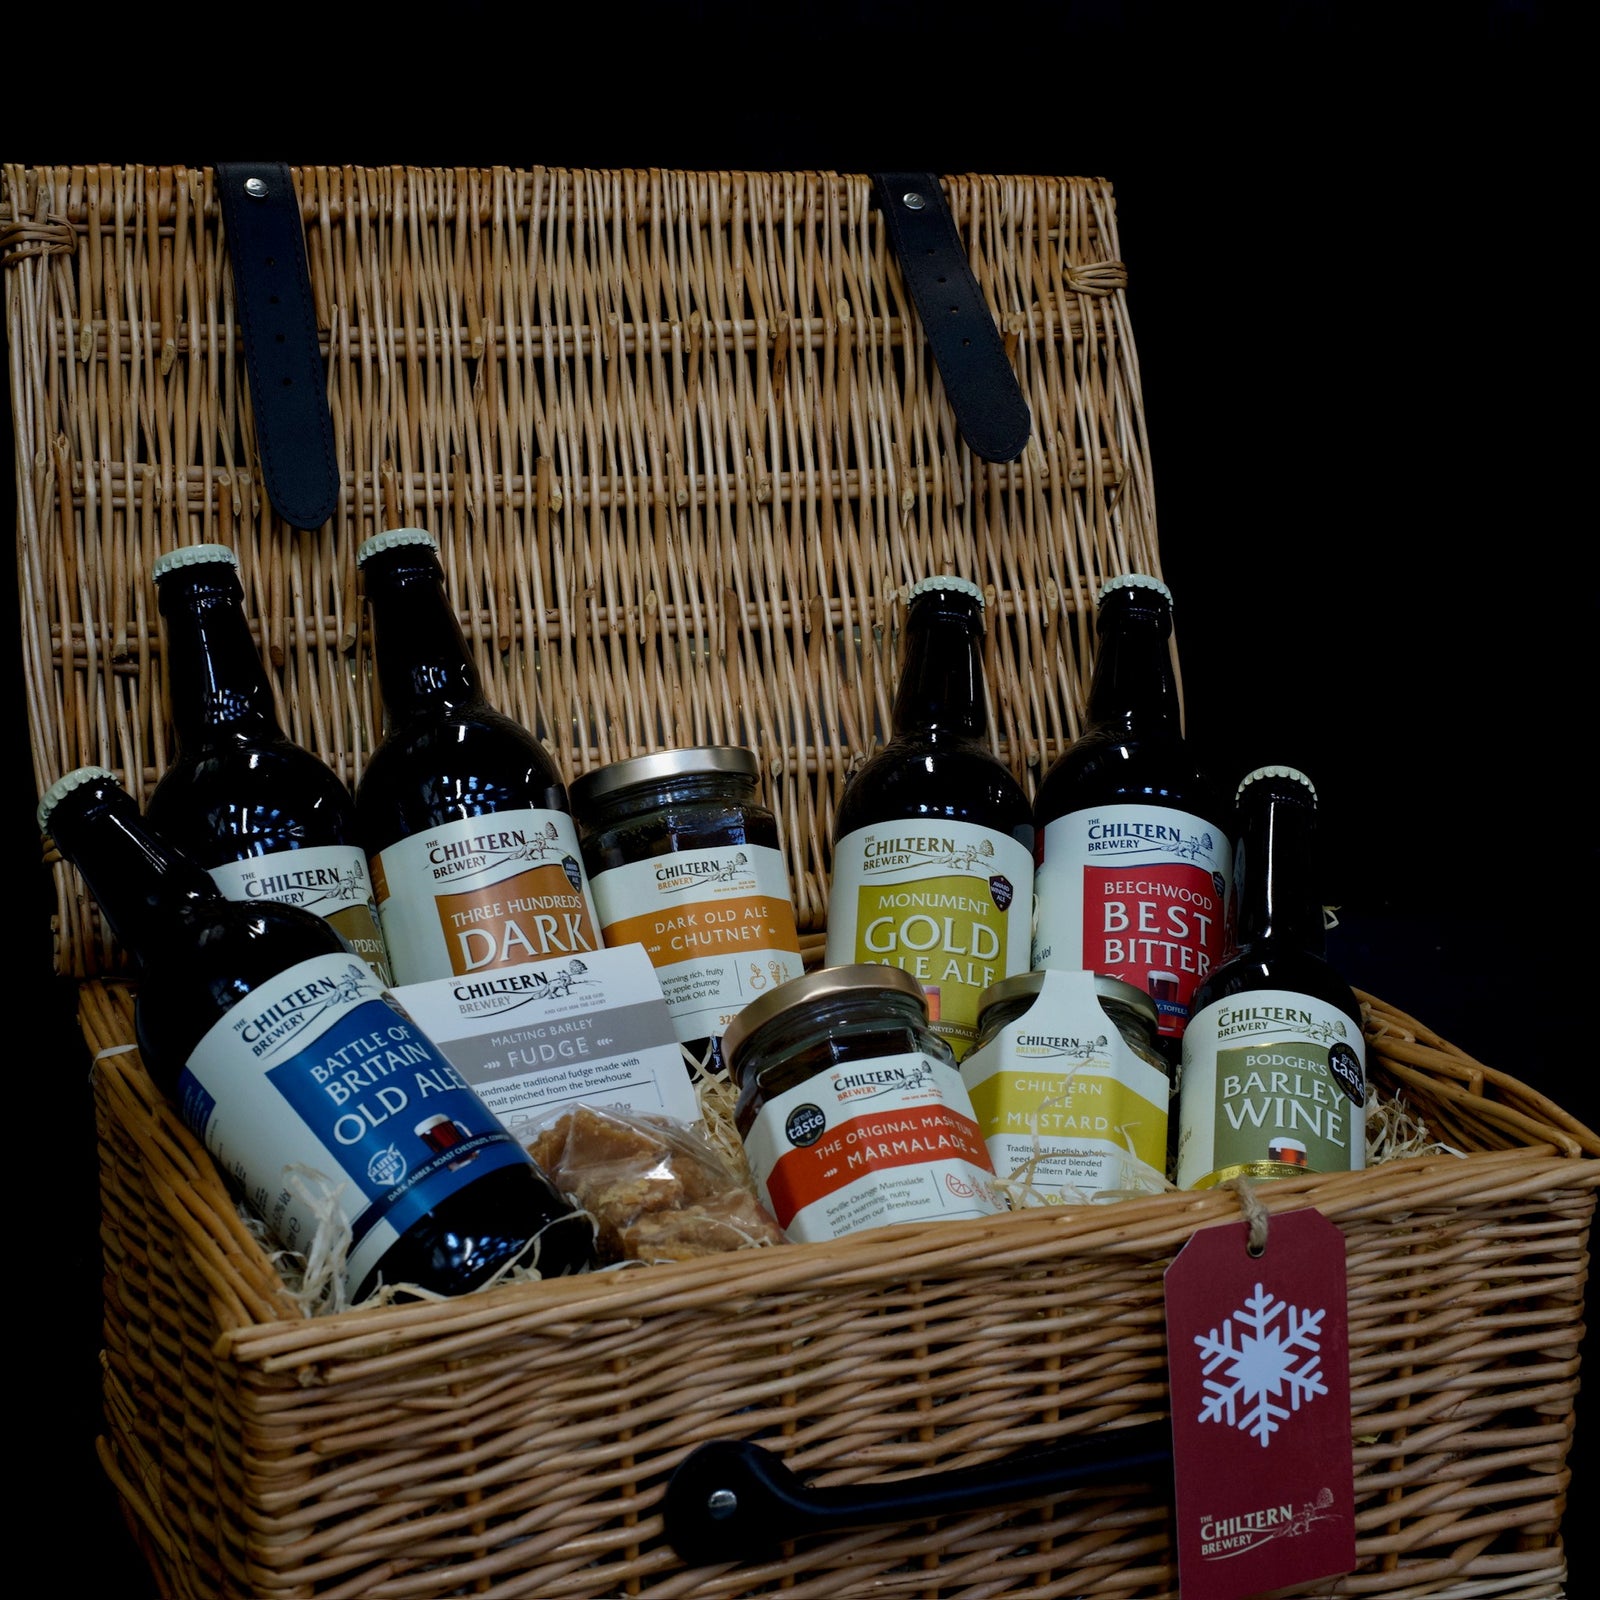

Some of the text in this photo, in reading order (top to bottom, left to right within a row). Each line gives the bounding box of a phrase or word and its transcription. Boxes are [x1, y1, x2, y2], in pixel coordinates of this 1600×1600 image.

[426, 839, 438, 848] THE
[864, 835, 875, 843] THE
[1087, 839, 1140, 851] BREWERY
[1088, 823, 1181, 842] CHILTERN
[429, 830, 526, 864] CHILTERN
[864, 837, 955, 857] CHILTERN
[433, 855, 487, 879] BREWERY
[656, 860, 720, 880] CHILTERN
[863, 855, 912, 870] BREWERY
[241, 872, 256, 880] THE
[244, 868, 340, 898] CHILTERN
[657, 876, 694, 890] BREWERY
[878, 893, 990, 915] MONUMENT
[1104, 881, 1213, 911] BEECHWOOD
[451, 895, 582, 927] THREE HUNDREDS
[655, 906, 768, 935] DARK OLD ALE
[1103, 901, 1213, 947] BEST
[457, 912, 593, 971] DARK
[671, 925, 762, 950] CHUTNEY
[865, 914, 1000, 961] GOLD
[1104, 938, 1211, 977] BITTER
[706, 968, 724, 977] fruity
[941, 959, 995, 988] ALE
[454, 971, 548, 1001] CHILTERN
[672, 984, 691, 994] apple
[693, 979, 720, 989] chutney
[676, 994, 692, 1003] Dark
[693, 990, 706, 999] Old
[242, 977, 337, 1042] CHILTERN
[459, 995, 511, 1014] BREWERY
[1217, 1007, 1312, 1027] CHILTERN
[232, 1018, 247, 1031] THE
[252, 1012, 305, 1056] BREWERY
[491, 1018, 593, 1047] MALTING BARLEY
[1217, 1021, 1269, 1039] BREWERY
[507, 1036, 590, 1069] FUDGE
[1016, 1035, 1080, 1048] CHILTERN
[309, 1025, 412, 1084] BATTLE OF
[1246, 1054, 1328, 1076] BODGER'S
[324, 1042, 432, 1106] BRITAIN
[523, 1072, 567, 1088] traditional
[568, 1066, 594, 1079] fudge
[595, 1062, 619, 1073] made
[622, 1057, 640, 1068] with
[834, 1068, 905, 1091] CHILTERN
[487, 1071, 632, 1108] malt pinched from the brewhouse
[837, 1086, 877, 1101] BREWERY
[1015, 1079, 1102, 1095] CHILTERN
[1223, 1071, 1346, 1111] BARLEY
[333, 1067, 468, 1145] OLD ALE
[789, 1114, 824, 1140] taste
[1007, 1111, 1109, 1130] MUSTARD
[1223, 1097, 1345, 1148] WINE
[815, 1140, 843, 1160] THE
[846, 1119, 918, 1145] ORIGINAL
[921, 1116, 955, 1128] MASH
[847, 1133, 968, 1169] MARMALADE
[1069, 1158, 1102, 1168] blended
[1065, 1168, 1083, 1177] Pale
[1084, 1169, 1098, 1177] Ale
[387, 1184, 408, 1202] DARK
[826, 1177, 924, 1217] Seville Orange Marmalade
[830, 1214, 847, 1226] with
[889, 1190, 910, 1199] nutty
[852, 1215, 871, 1226] from
[872, 1208, 885, 1217] our
[886, 1197, 931, 1211] Brewhouse
[1200, 1514, 1213, 1524] THE
[1200, 1504, 1292, 1541] CHILTERN
[1201, 1533, 1253, 1556] BREWERY
